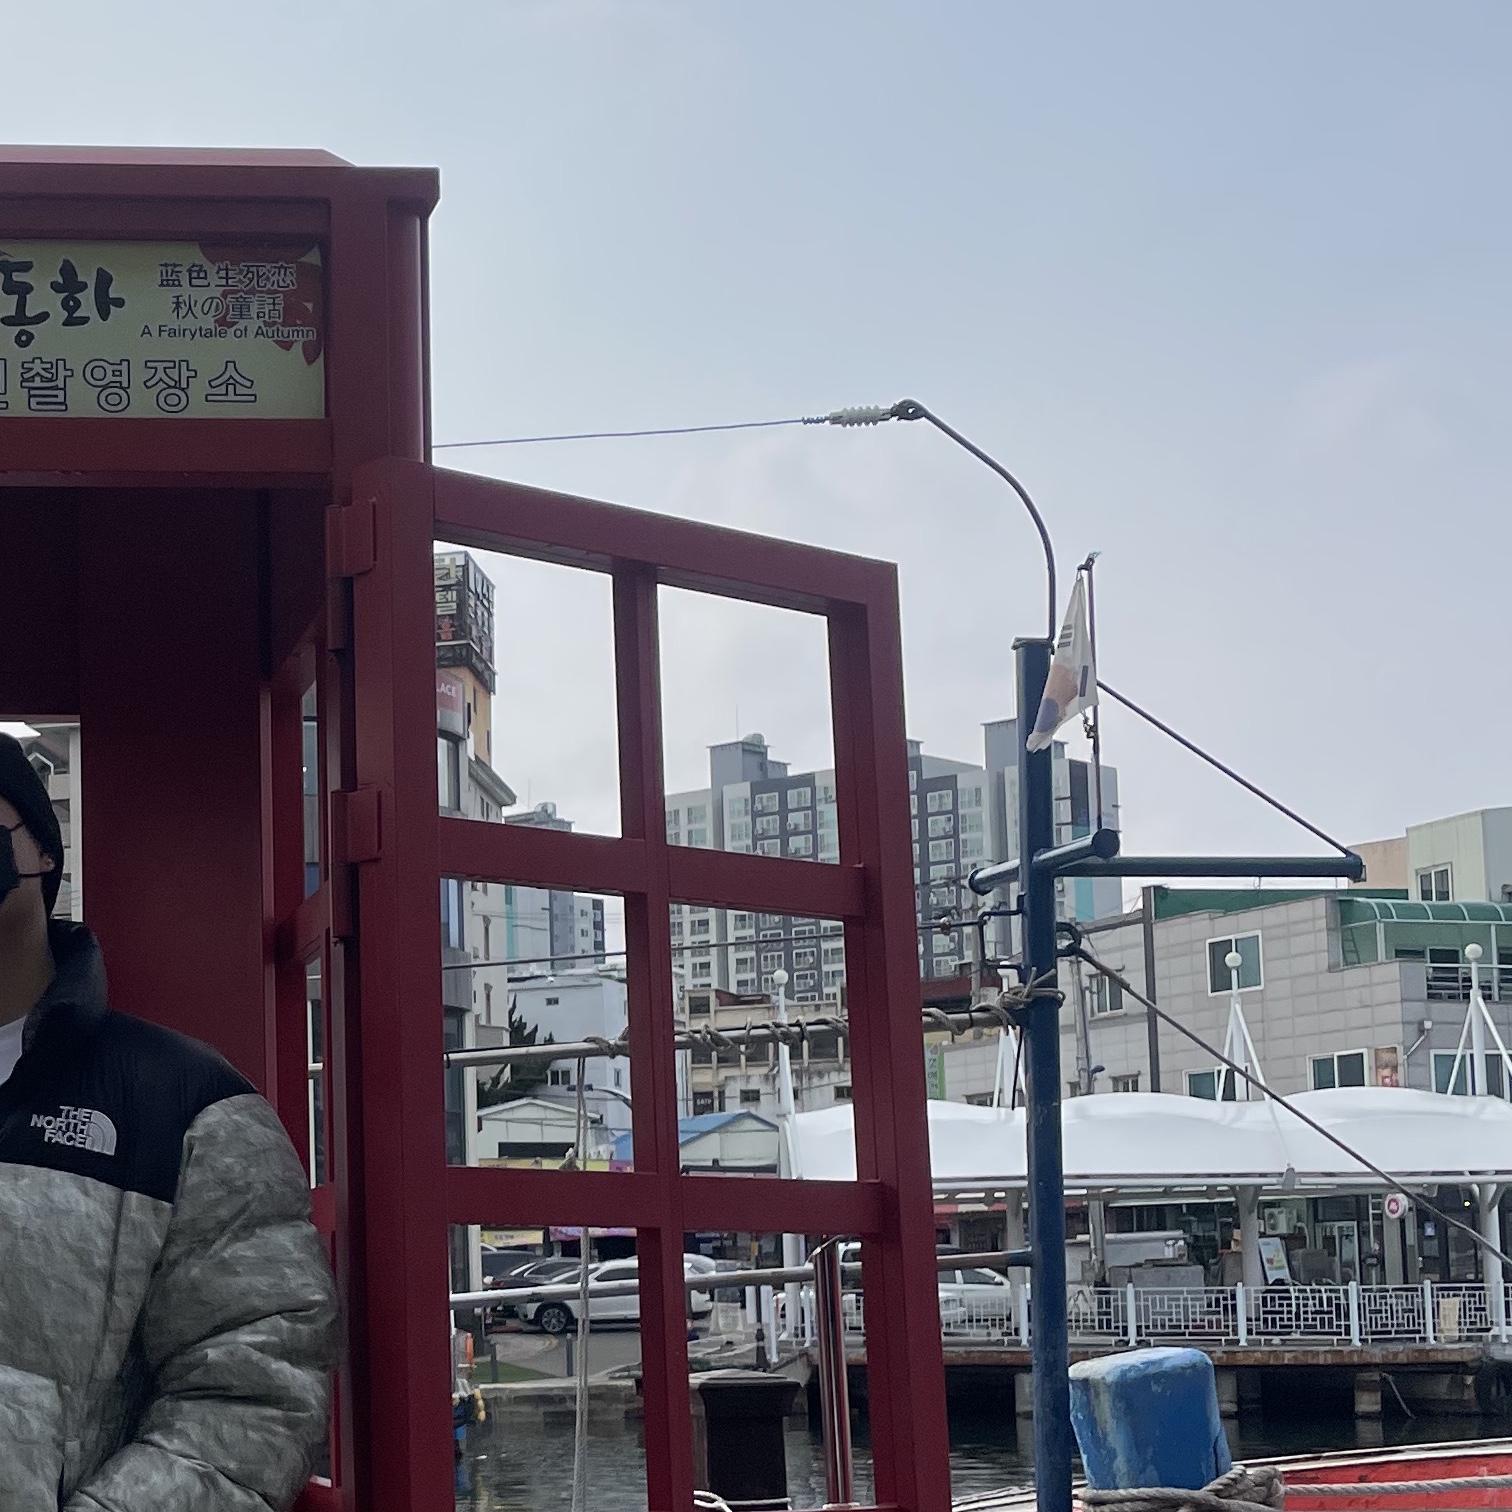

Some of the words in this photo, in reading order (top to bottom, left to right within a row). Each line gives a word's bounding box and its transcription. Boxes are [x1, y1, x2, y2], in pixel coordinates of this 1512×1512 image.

[157, 262, 297, 290] 蓝色生死恋
[170, 293, 284, 321] 秋の童話
[140, 325, 153, 339] A
[158, 325, 228, 341] Fairytale
[233, 325, 248, 340] of
[254, 325, 316, 340] Autumn
[59, 1105, 93, 1122] THE
[30, 1114, 88, 1136] NORTH
[44, 1129, 86, 1148] FACE
